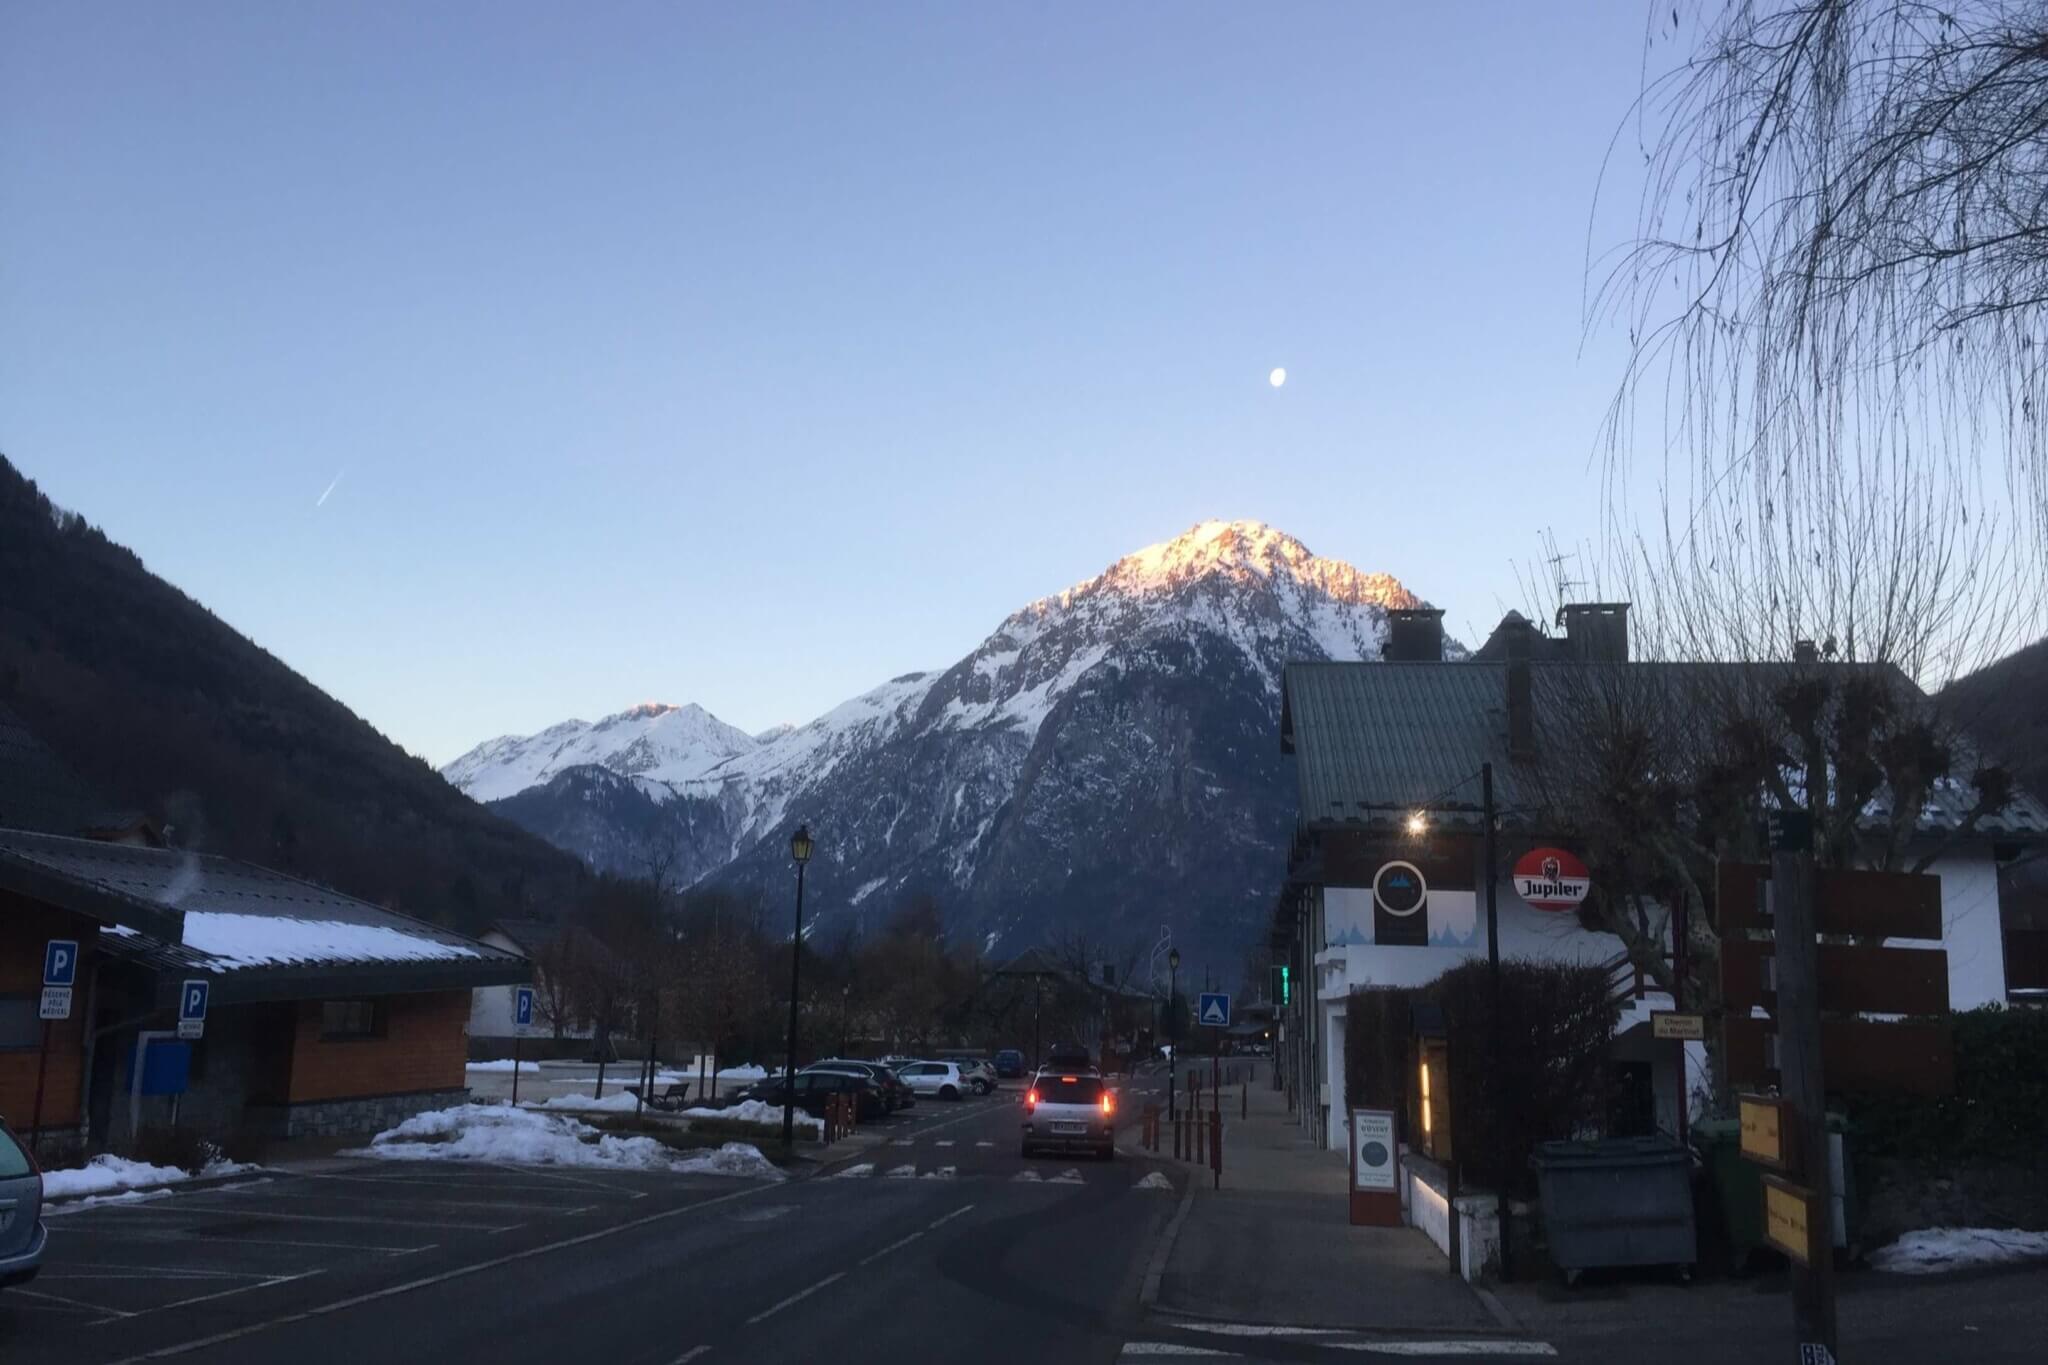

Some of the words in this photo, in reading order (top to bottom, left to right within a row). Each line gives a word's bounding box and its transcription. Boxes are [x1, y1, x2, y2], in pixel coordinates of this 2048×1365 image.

[1523, 879, 1583, 898] Jupiler
[52, 949, 69, 977] P
[188, 989, 202, 1013] P
[519, 995, 529, 1018] P
